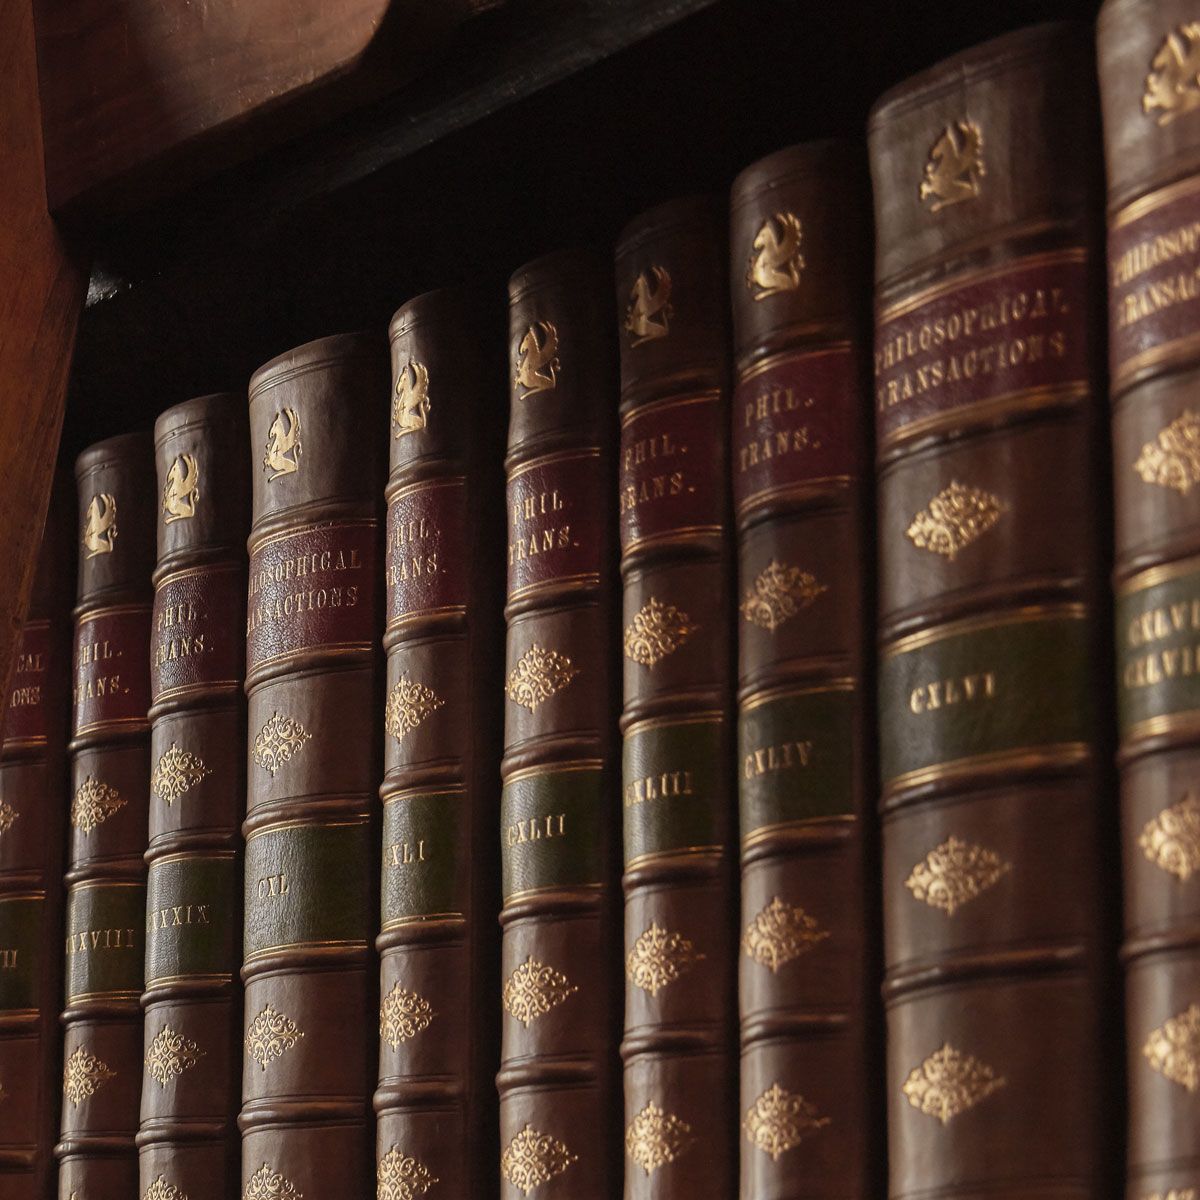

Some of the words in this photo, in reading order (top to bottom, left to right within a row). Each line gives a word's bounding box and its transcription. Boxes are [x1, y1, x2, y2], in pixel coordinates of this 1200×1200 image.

[744, 387, 814, 428] PHIL.
[624, 434, 688, 472] PHIL.
[740, 426, 822, 473] TRANS.
[509, 525, 580, 566] TRANS.
[250, 549, 362, 599] ILOSOPHICAL
[246, 586, 359, 640] ANSACTIONS
[507, 813, 567, 847] CXLII
[257, 872, 290, 900] CXL
[65, 927, 136, 955] XXVIII
